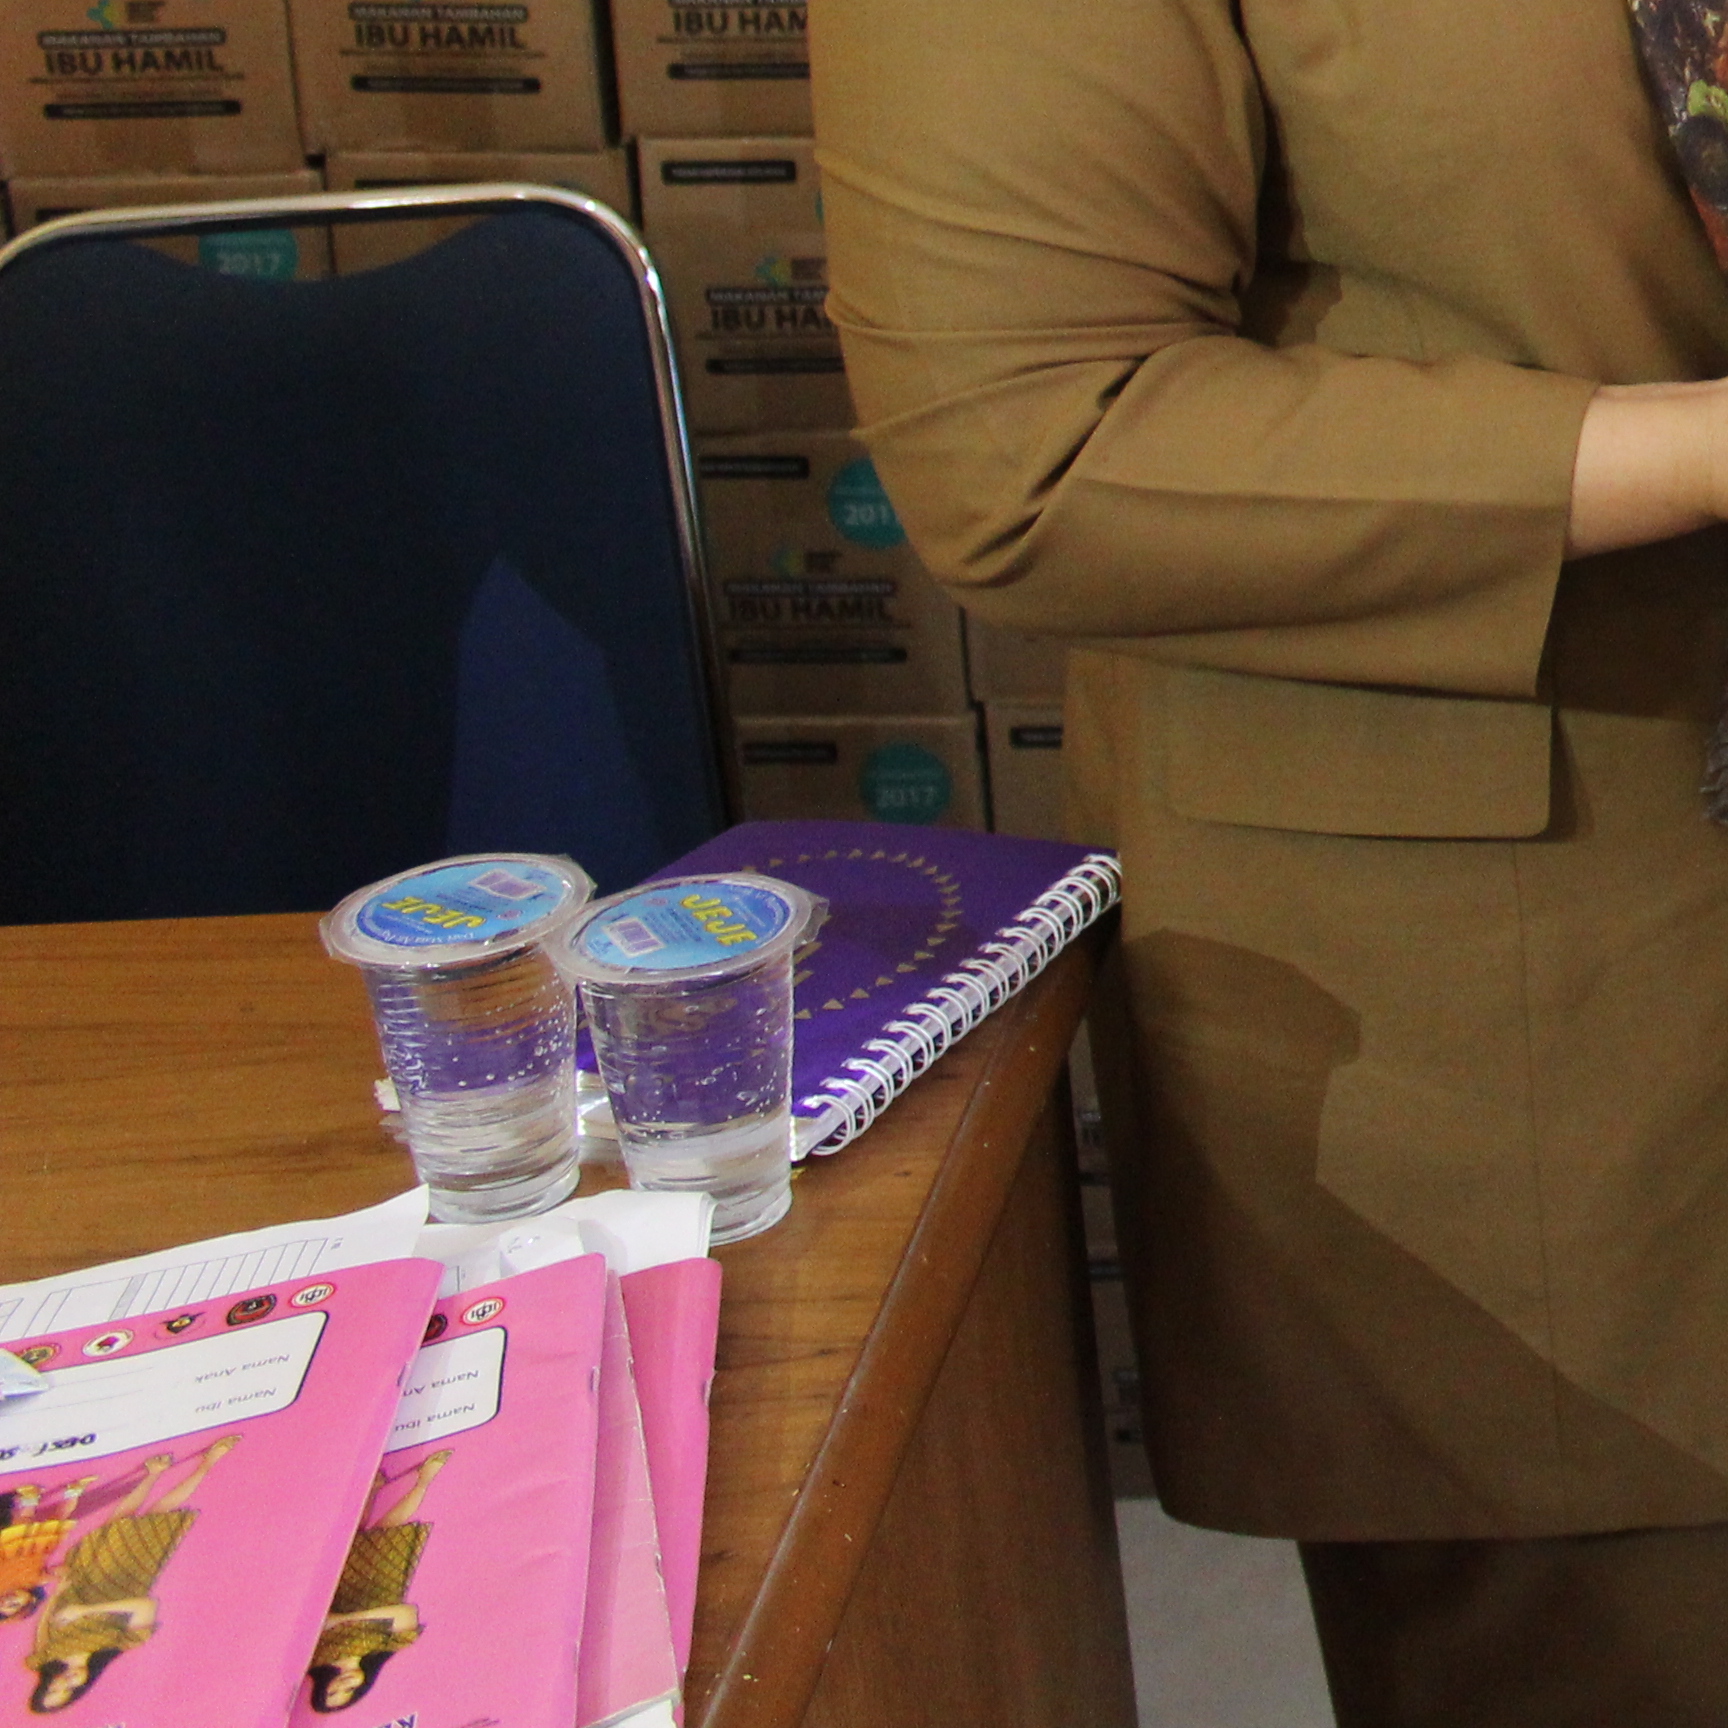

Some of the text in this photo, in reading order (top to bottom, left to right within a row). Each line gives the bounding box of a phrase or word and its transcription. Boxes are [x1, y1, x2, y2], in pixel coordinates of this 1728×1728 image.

[712, 308, 764, 332] IBU
[381, 896, 486, 930] JEJE
[680, 894, 759, 947] JEJE
[431, 1370, 479, 1391] Nama
